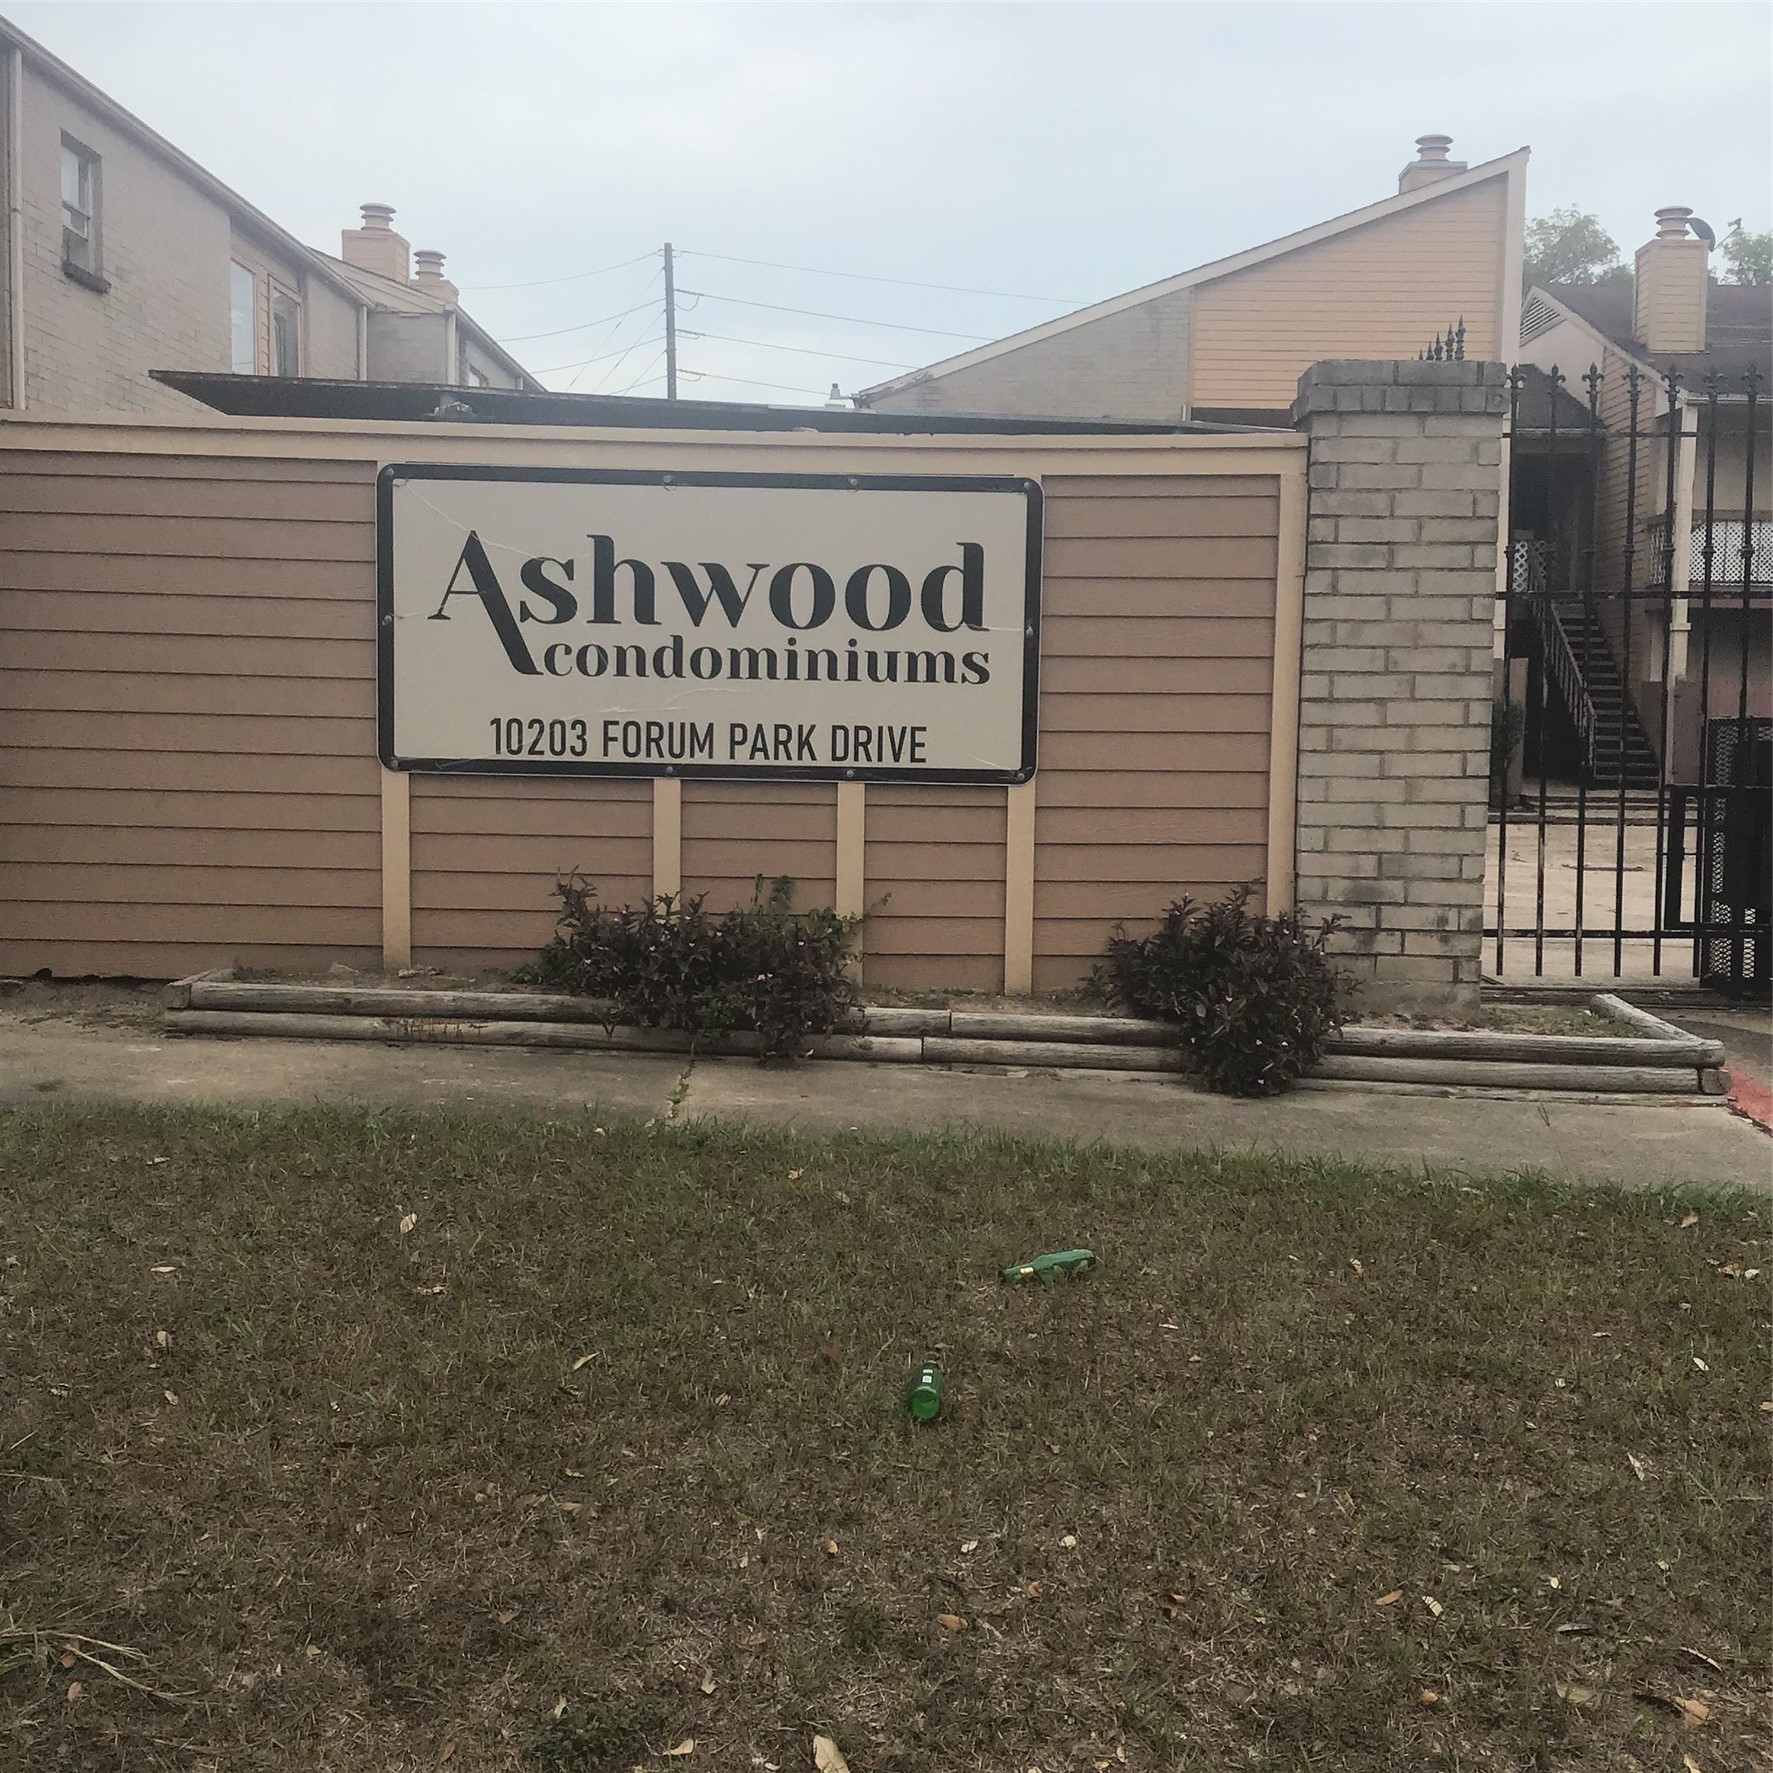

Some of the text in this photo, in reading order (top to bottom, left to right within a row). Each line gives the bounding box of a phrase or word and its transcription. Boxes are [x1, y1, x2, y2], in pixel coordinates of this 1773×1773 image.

[427, 530, 990, 676] Ashwood
[543, 635, 991, 684] condominiums
[489, 717, 927, 763] 10203 FORUM PARK DRIVE
